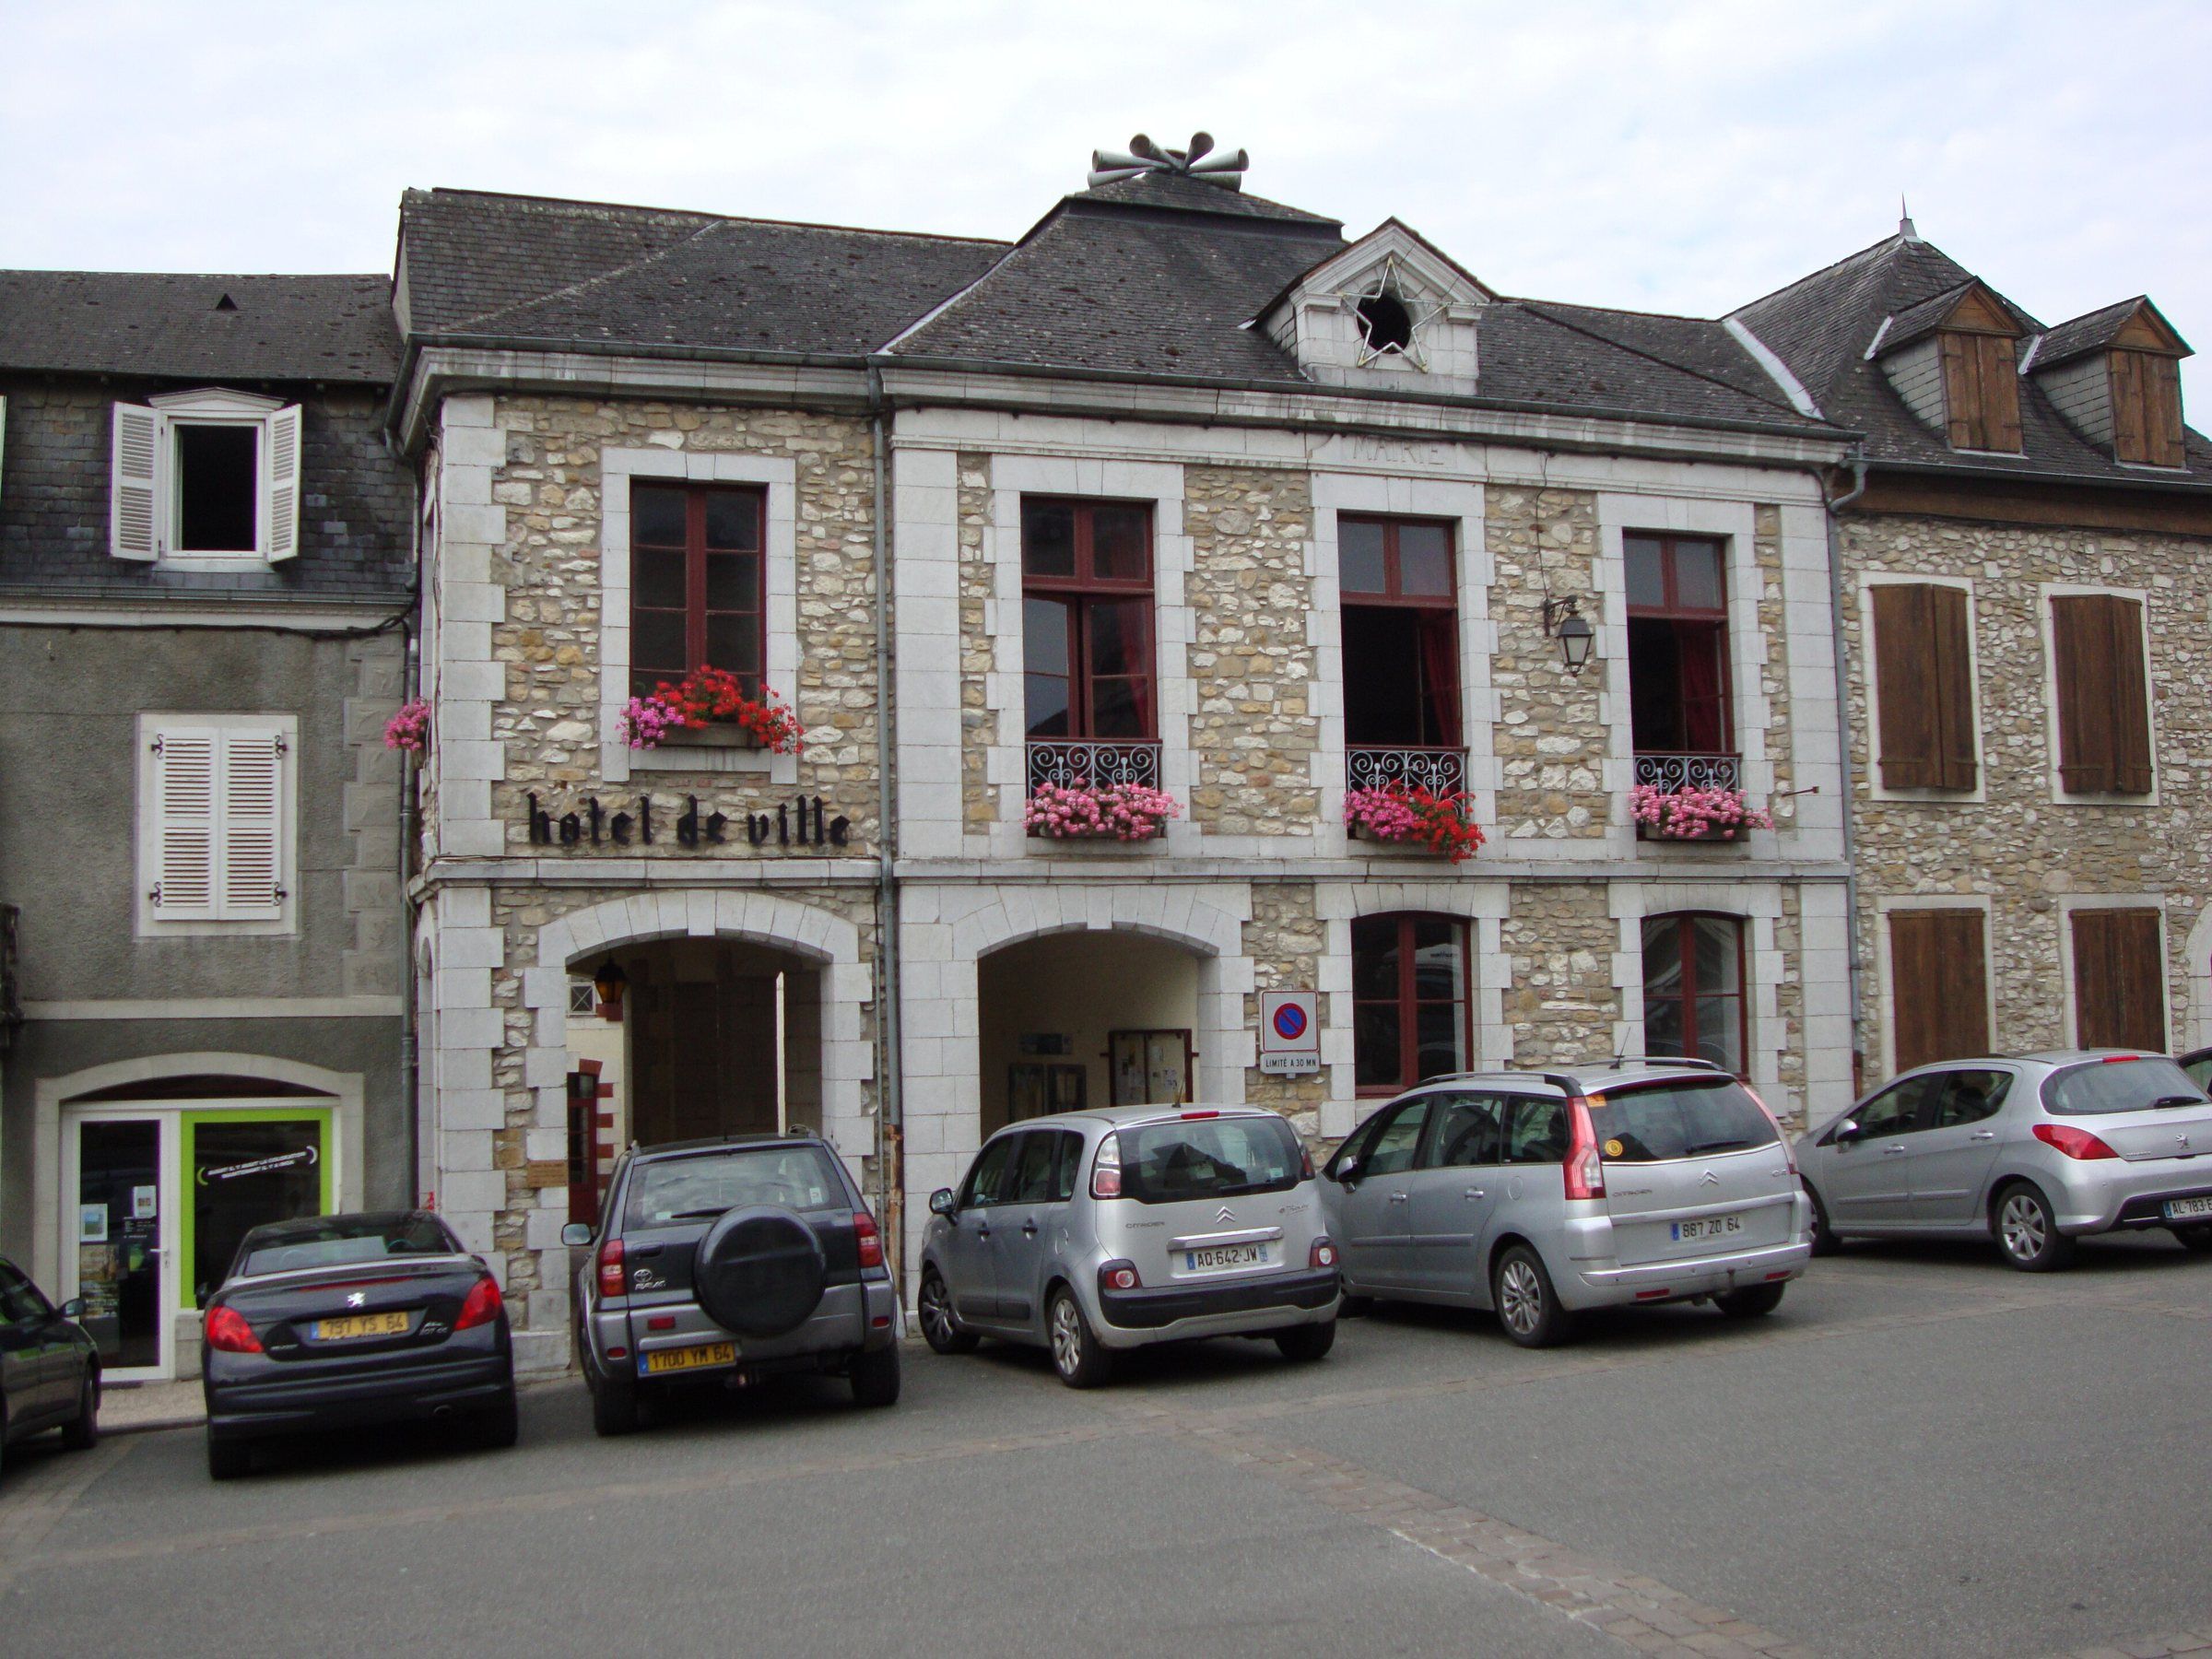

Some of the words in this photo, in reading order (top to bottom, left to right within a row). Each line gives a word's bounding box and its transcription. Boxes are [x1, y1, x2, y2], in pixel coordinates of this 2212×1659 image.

[1352, 434, 1445, 465] MAIRIE
[677, 794, 728, 847] de
[747, 794, 852, 847] ville
[1265, 1057, 1287, 1068] LIMITÉ
[1296, 1058, 1304, 1067] 30
[1306, 1058, 1317, 1067] MN
[1727, 1216, 1741, 1231] 64
[714, 1345, 730, 1360] 64
